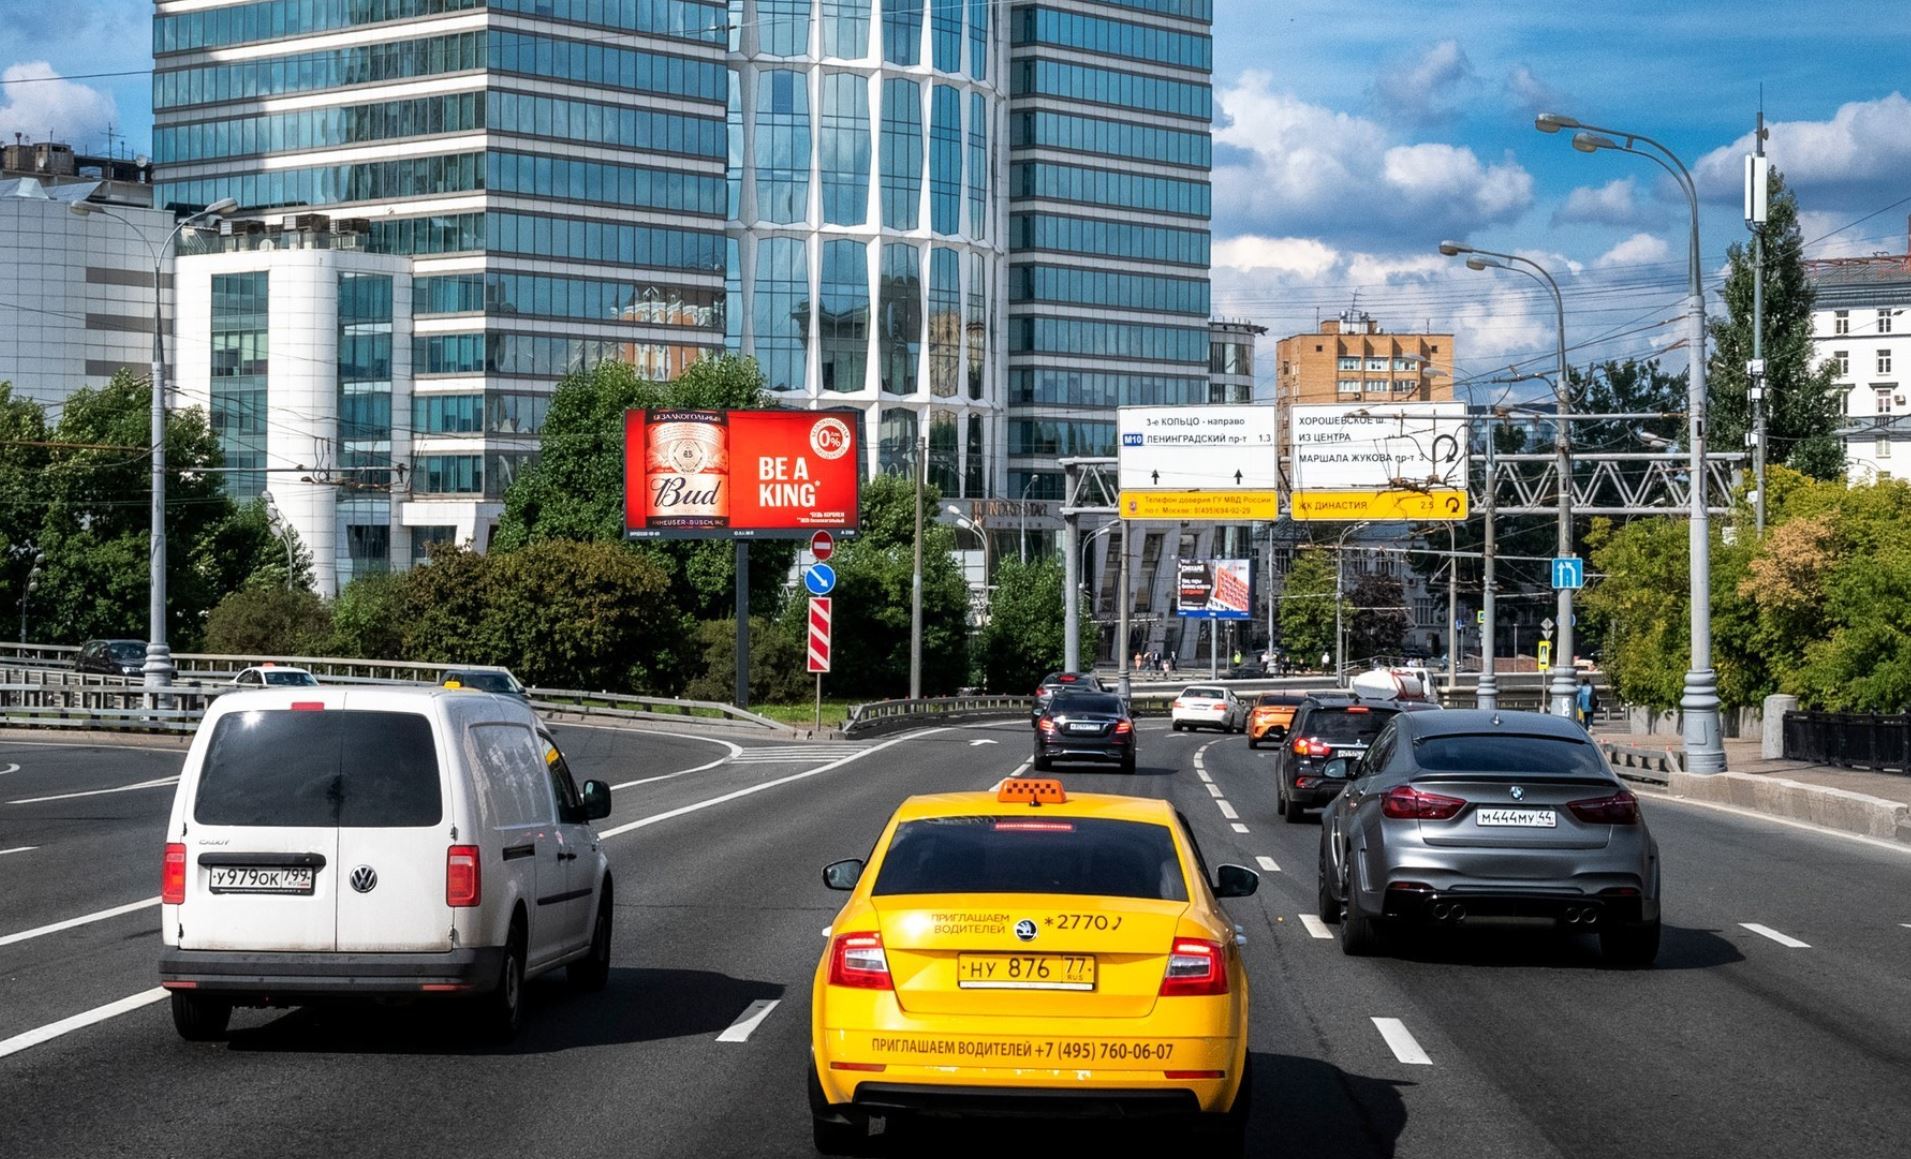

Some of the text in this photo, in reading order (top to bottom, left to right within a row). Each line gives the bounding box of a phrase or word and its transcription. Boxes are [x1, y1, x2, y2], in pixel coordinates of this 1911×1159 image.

[1146, 418, 1159, 426] 3-е
[1161, 418, 1200, 427] КОЛЬЦО
[1207, 418, 1245, 426] направо
[1298, 416, 1373, 425] ХОРОШЕВСКОЕ
[1124, 434, 1142, 444] М10
[1147, 433, 1272, 444] ЛЕНИНГРАДСКИЙ пр-т 1.3
[1299, 433, 1351, 442] ИЗ ЦЕНТРА
[1299, 454, 1349, 463] МАРШАЛА
[1351, 454, 1392, 462] ЖУКОВА
[1394, 455, 1415, 464] пр-т
[758, 456, 808, 481] BE A
[650, 477, 722, 507] Bud
[1144, 496, 1176, 504] Телефон
[1213, 496, 1222, 504] ГУ
[1224, 496, 1242, 504] МВД
[1243, 496, 1271, 504] России
[1315, 501, 1368, 510] ДИНАСТИЯ
[1482, 811, 1535, 824] М444МУ
[1538, 812, 1552, 822] 44
[217, 868, 308, 886] У979ОК 799
[931, 914, 1010, 923] ПРИГЛАШАЕМ
[934, 924, 1006, 935] ВОДИТЕЛЕЙ
[971, 958, 1086, 978] НУ 876 77
[872, 1038, 1174, 1061] ПРИГЛАШАЕМ ВОДИТЕЛЕЙ +7 (495) 760-06-07
